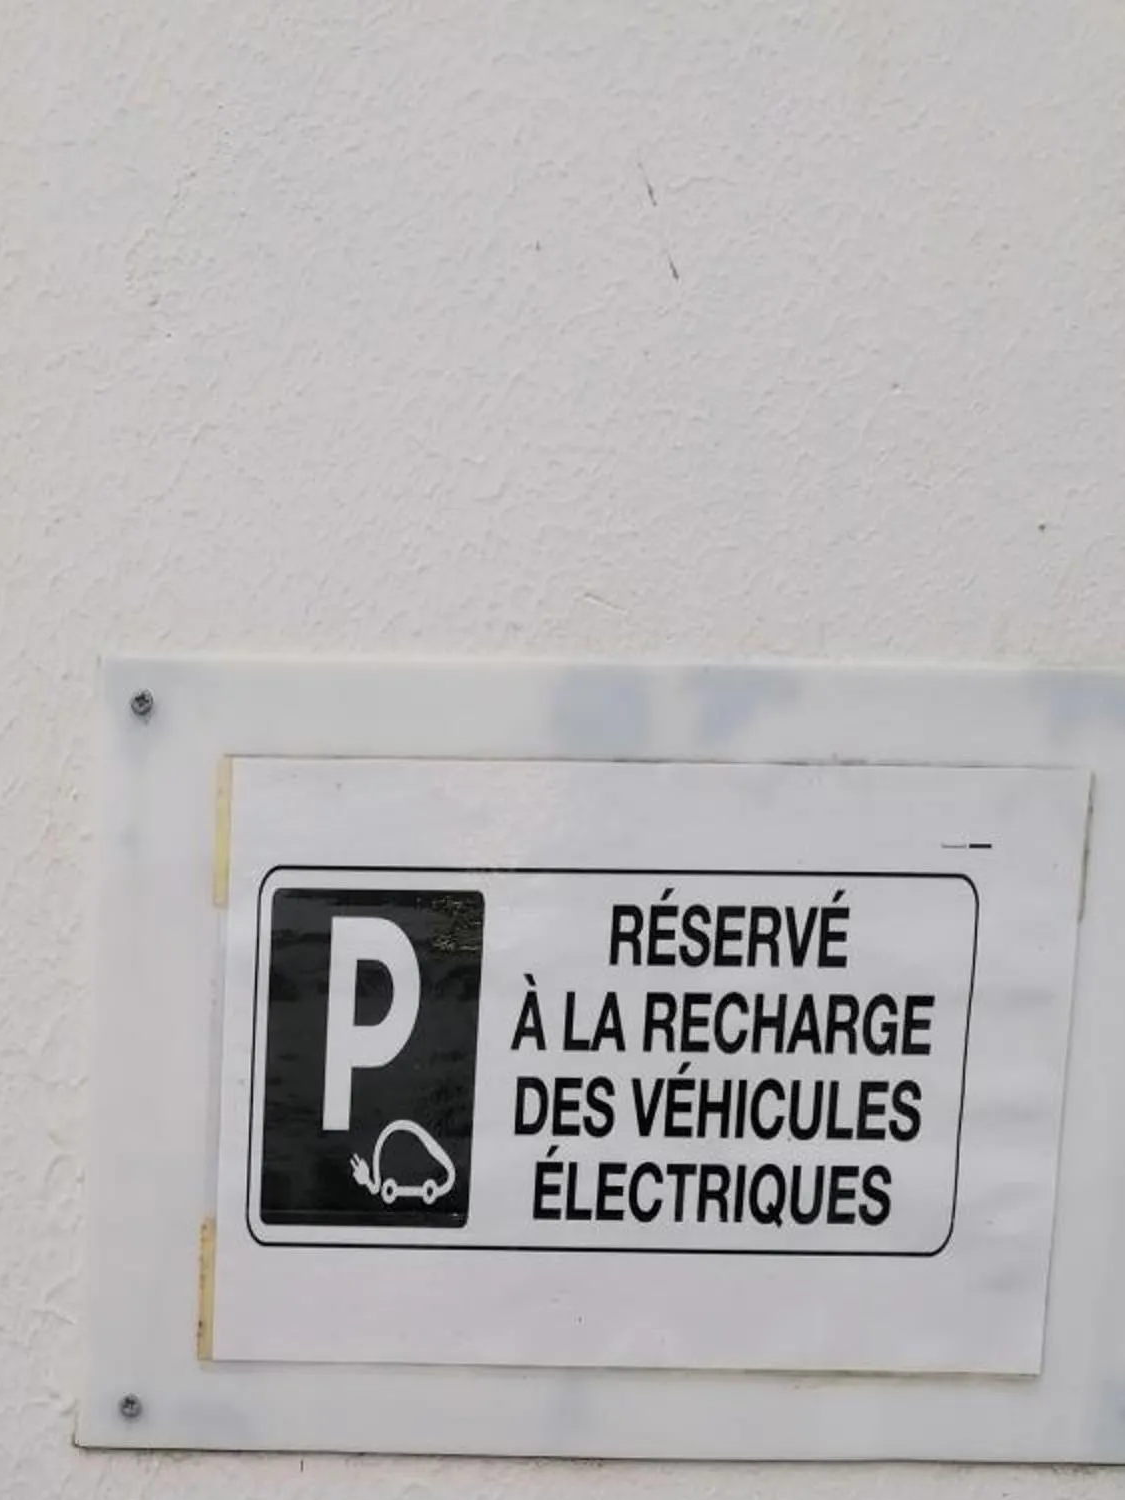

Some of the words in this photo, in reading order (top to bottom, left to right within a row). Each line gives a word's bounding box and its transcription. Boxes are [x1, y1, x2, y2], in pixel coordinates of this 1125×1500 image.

[610, 888, 849, 968] RÉSERVÉ
[324, 916, 421, 1131] P
[511, 974, 546, 1050] À
[563, 992, 625, 1051] LA
[643, 992, 935, 1056] RECHARGE
[515, 1076, 615, 1138] DES
[632, 1062, 921, 1141] VÉHICULES
[533, 1145, 891, 1227] ÉLECTRIQUES
